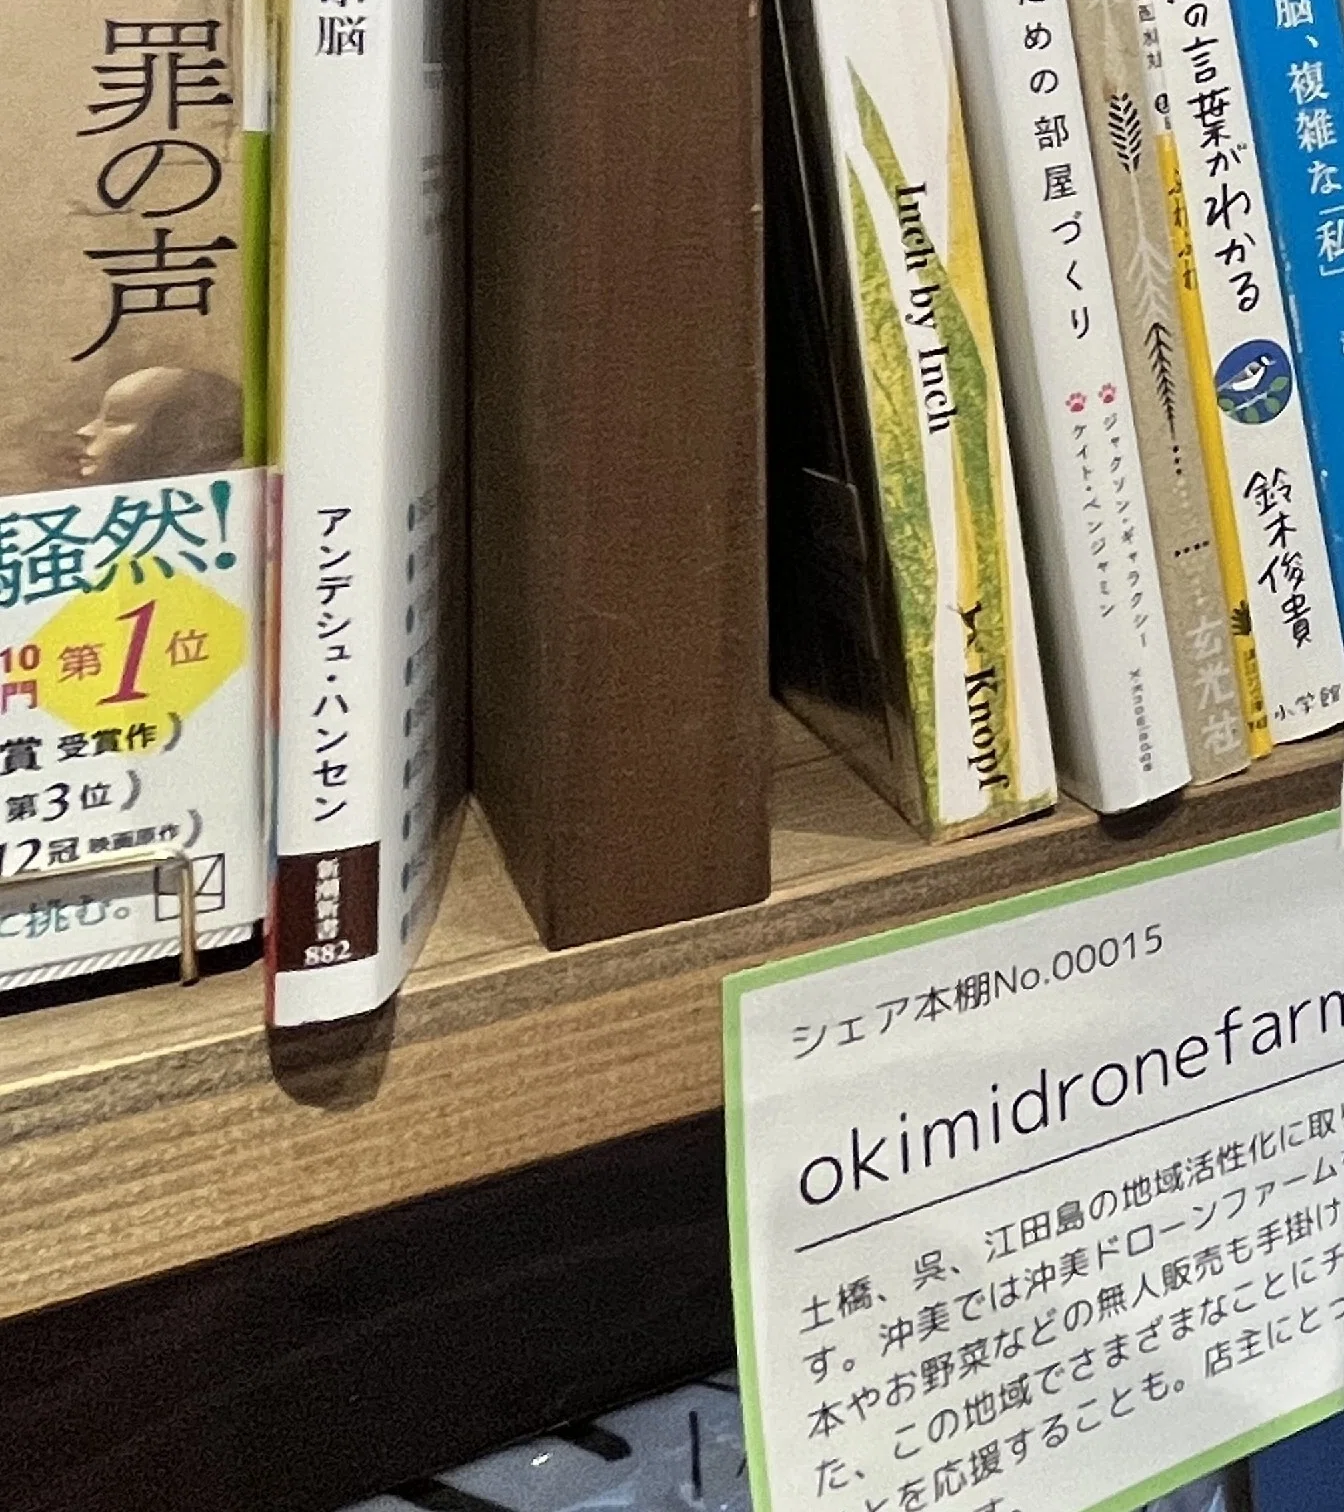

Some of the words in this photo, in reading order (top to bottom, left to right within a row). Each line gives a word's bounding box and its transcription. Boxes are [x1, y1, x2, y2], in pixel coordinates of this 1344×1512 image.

[70, 19, 238, 363] 罪の声
[896, 181, 932, 271] Inch
[903, 281, 941, 332] by
[917, 343, 958, 435] Inch
[1244, 468, 1313, 647] 鈴木俊貴
[57, 598, 209, 707] 第1位
[311, 505, 352, 823] アンデシュ・ハンセン
[965, 665, 1009, 790] Knopf
[303, 939, 352, 967] 882
[791, 923, 1164, 1058] シェア本棚No.00015
